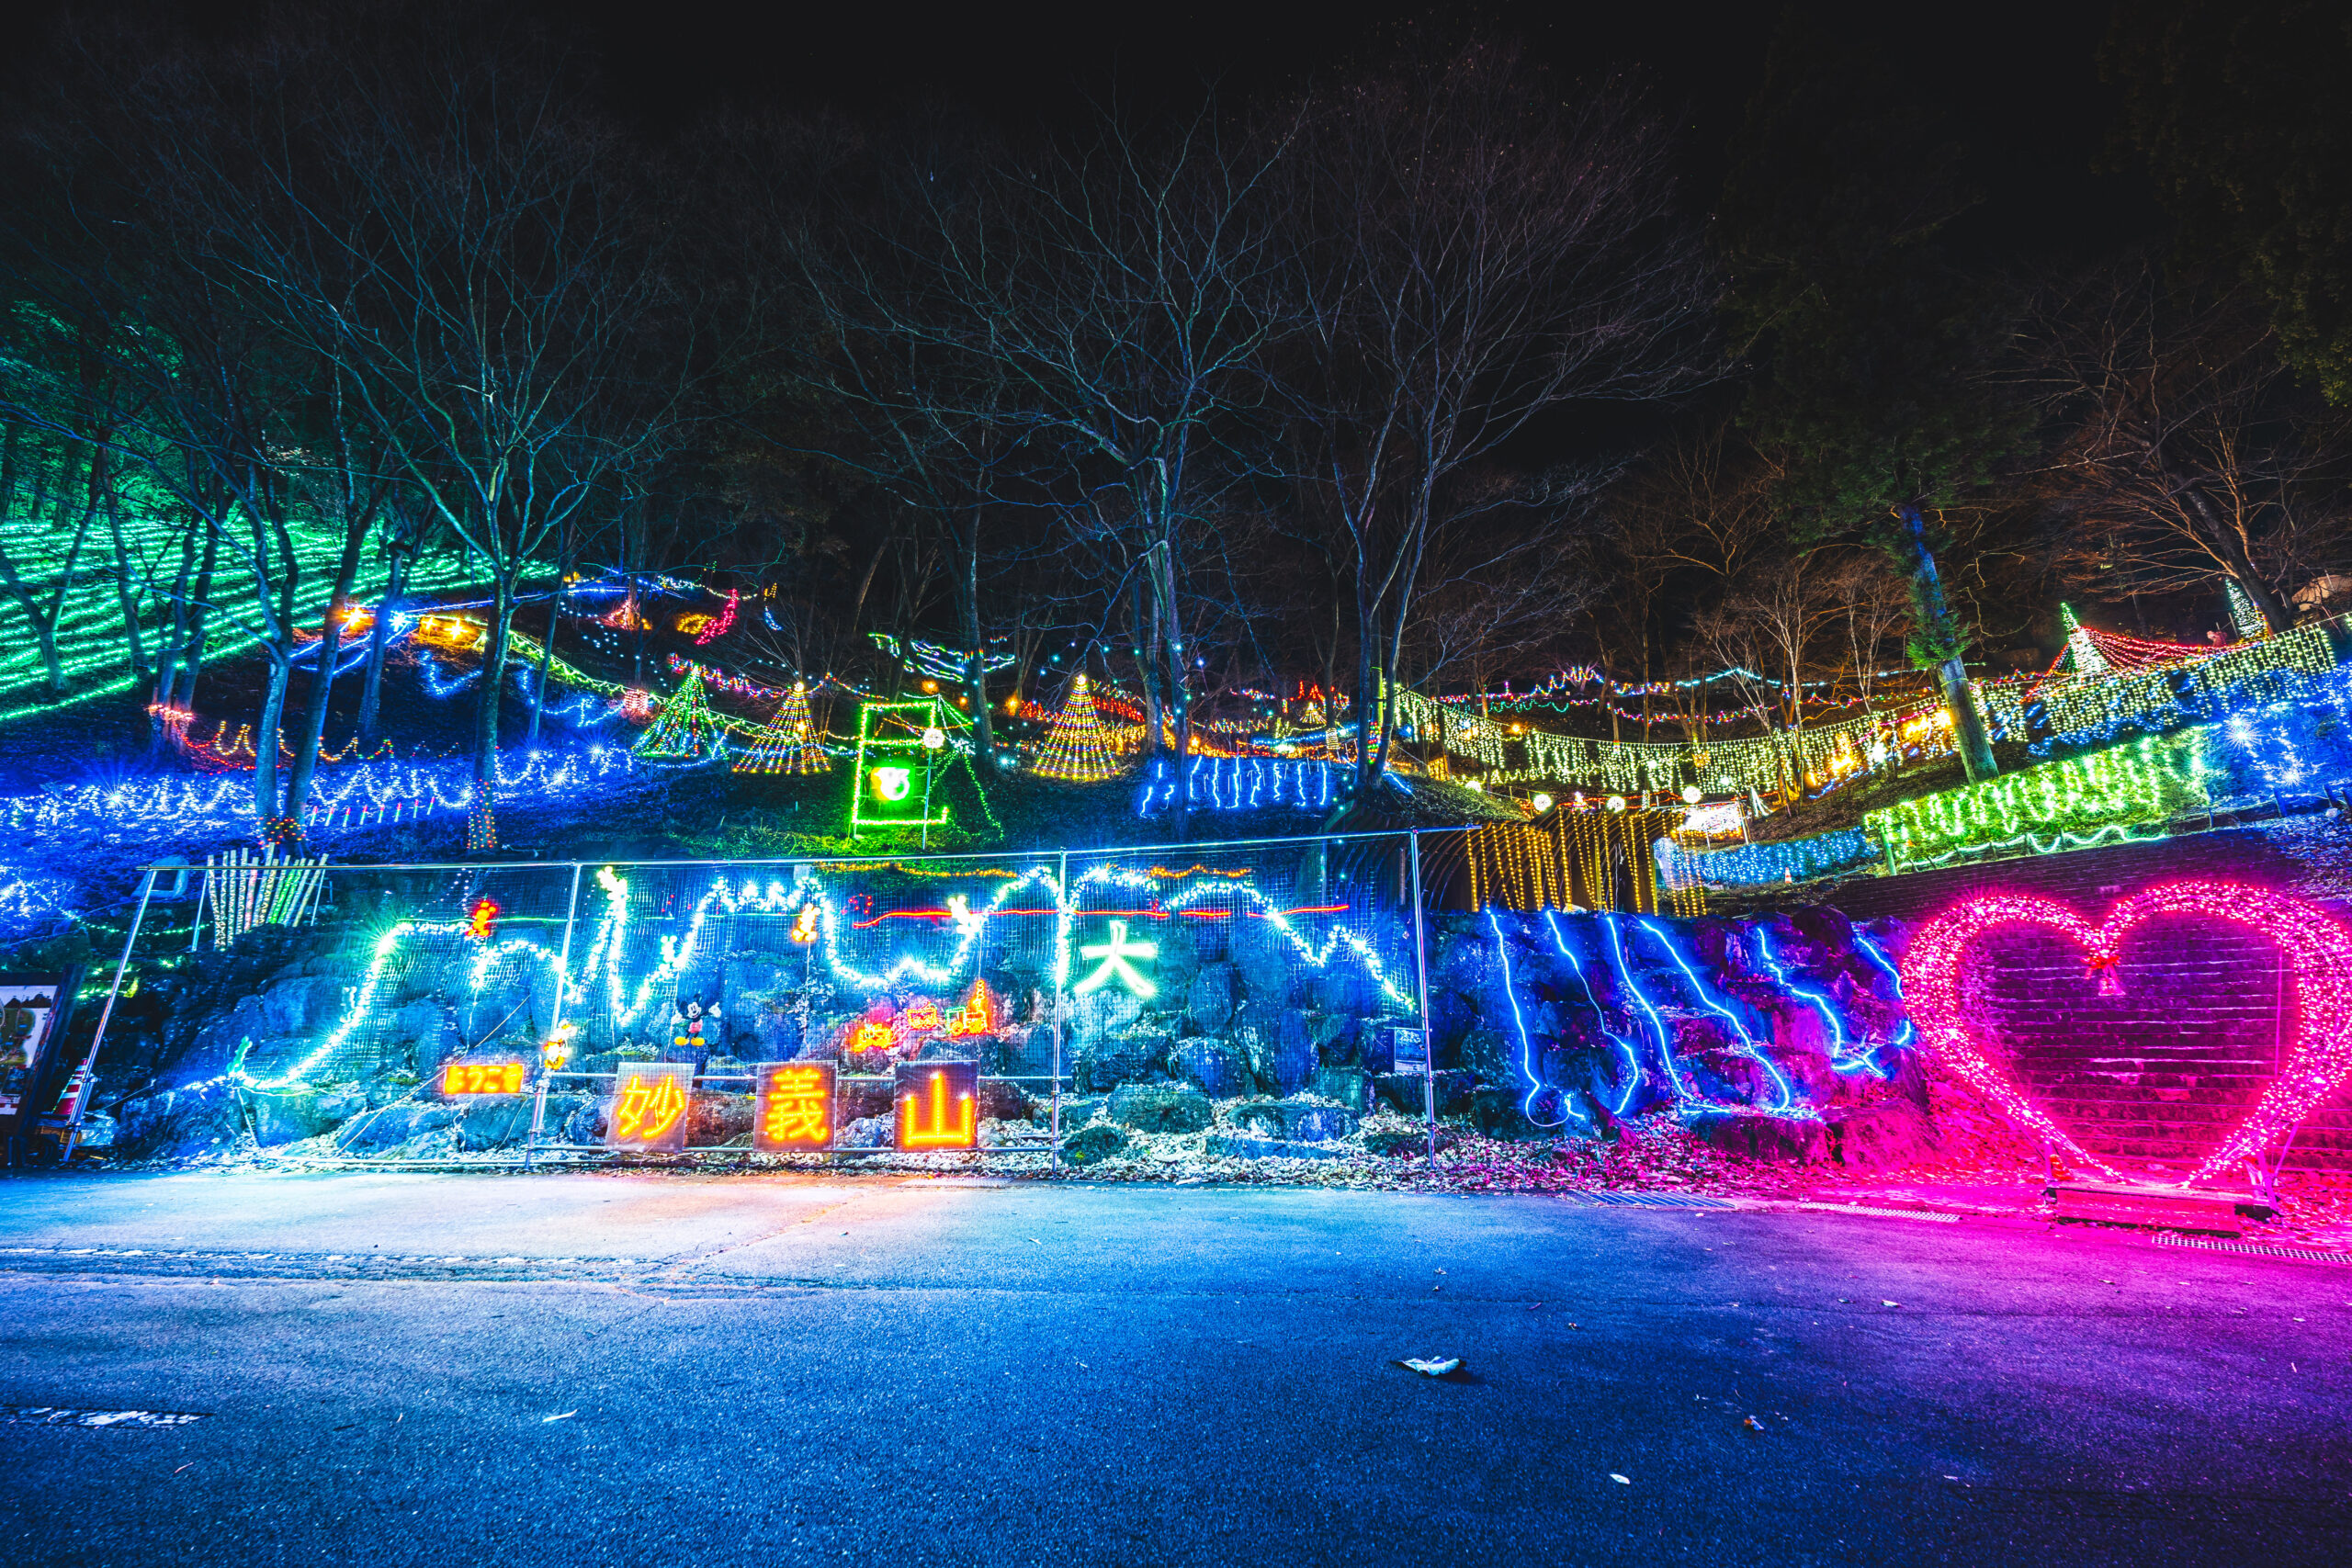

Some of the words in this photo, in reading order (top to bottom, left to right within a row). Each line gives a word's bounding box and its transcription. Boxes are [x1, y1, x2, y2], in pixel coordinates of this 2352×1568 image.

[1073, 919, 1159, 998] 大
[445, 1064, 523, 1094] ようこそ
[616, 1066, 974, 1146] 妙義山
